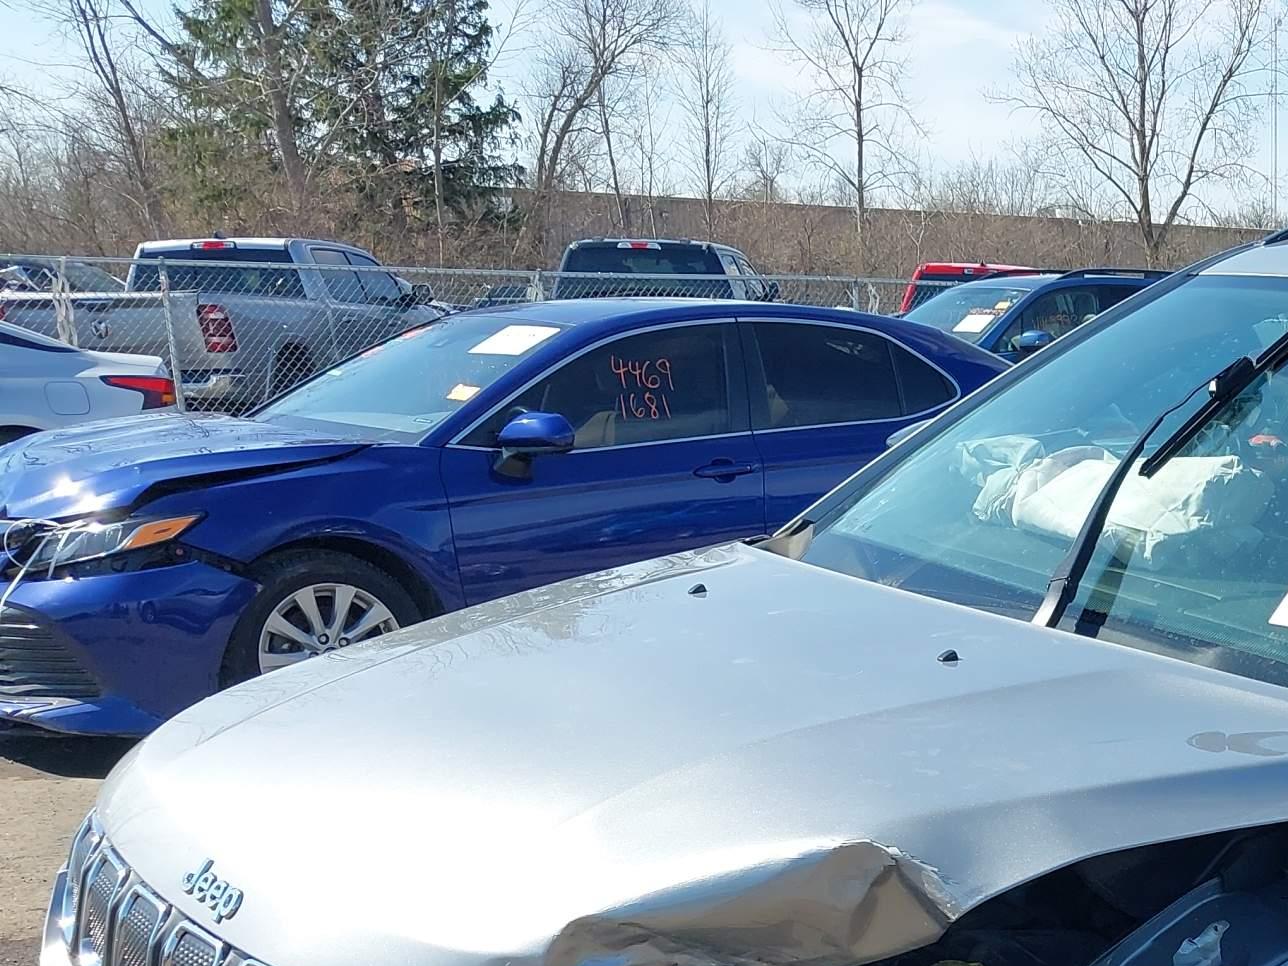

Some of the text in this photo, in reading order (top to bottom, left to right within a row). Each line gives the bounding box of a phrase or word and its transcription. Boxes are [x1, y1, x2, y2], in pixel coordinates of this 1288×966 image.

[611, 355, 674, 391] 4469
[620, 391, 671, 419] 1681
[183, 858, 244, 924] Jeep
